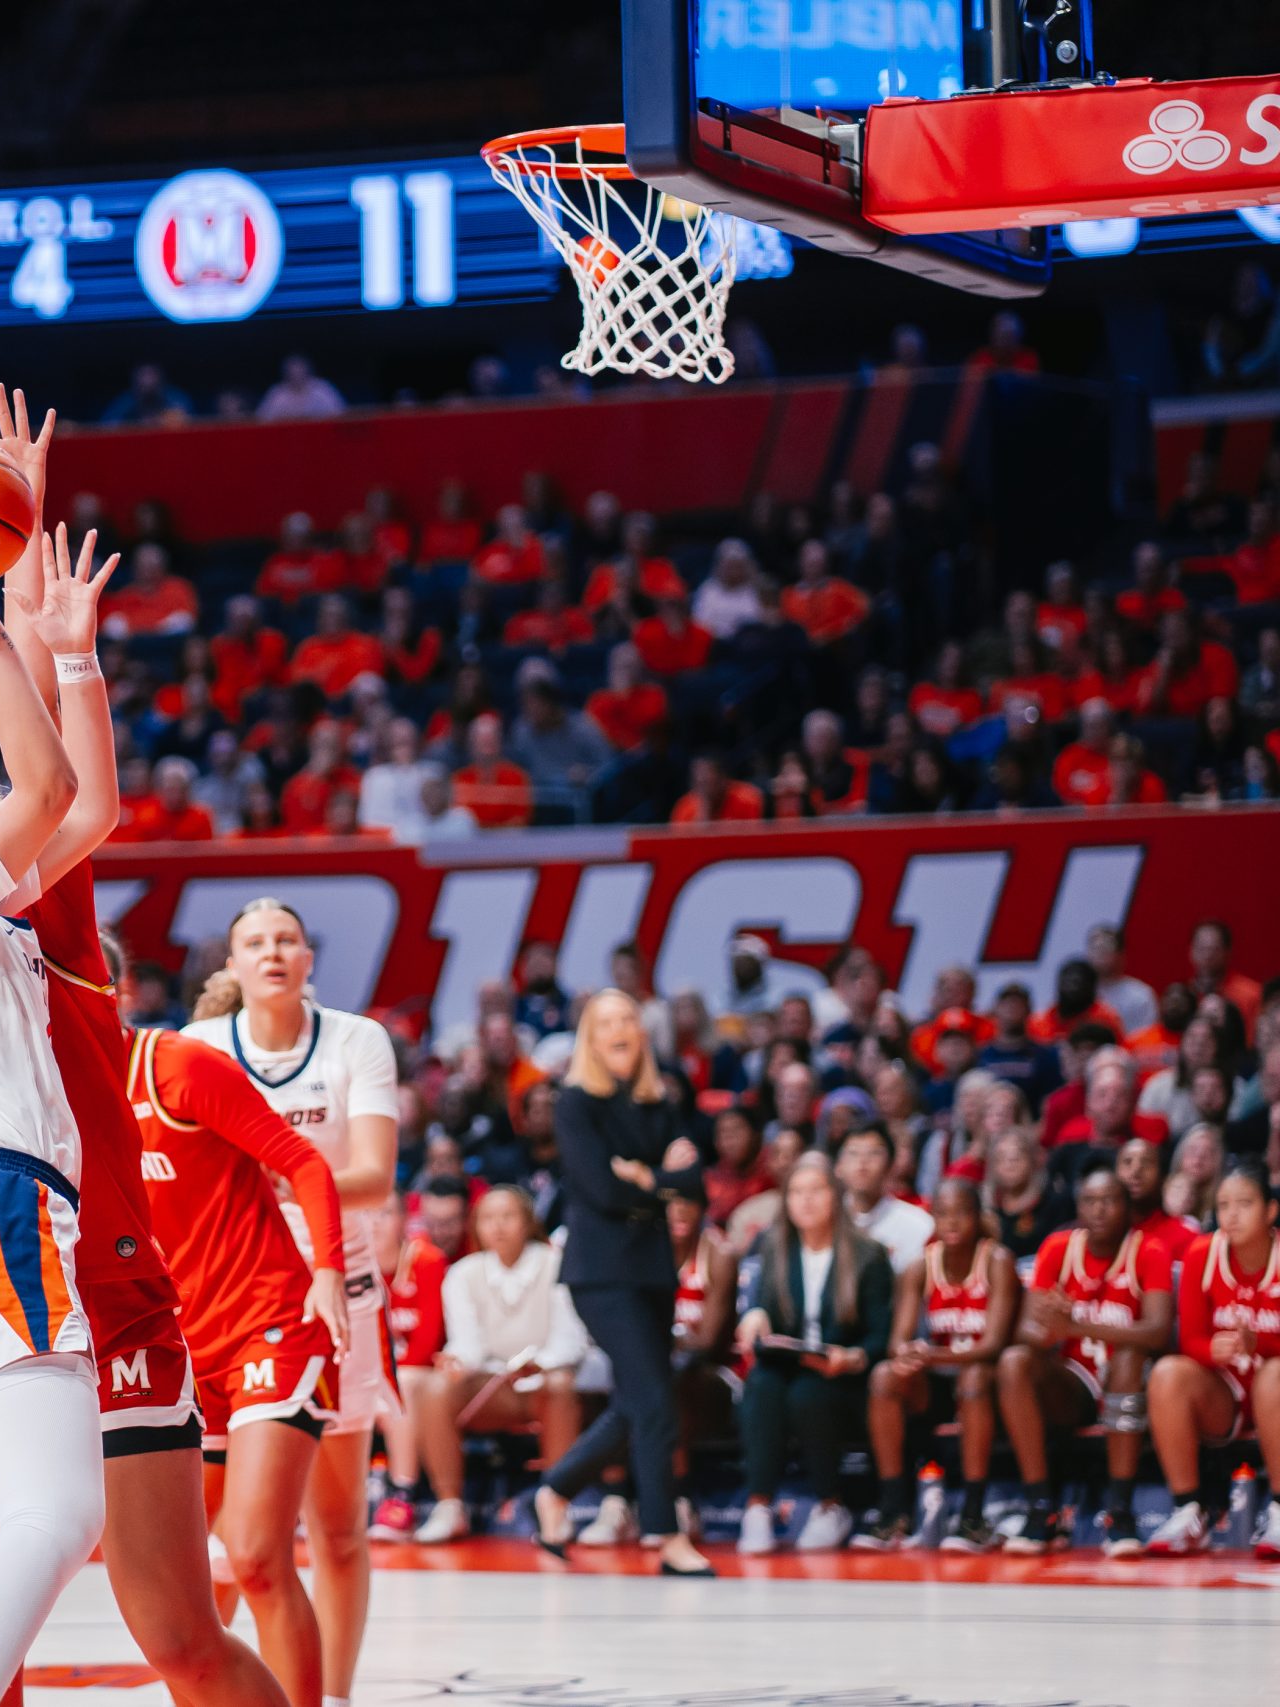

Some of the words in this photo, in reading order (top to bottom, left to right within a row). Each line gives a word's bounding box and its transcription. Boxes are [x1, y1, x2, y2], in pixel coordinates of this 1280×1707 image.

[11, 240, 73, 319] 4
[349, 170, 457, 311] 11
[94, 845, 1145, 1055] RUSH
[111, 1348, 152, 1393] M
[242, 1357, 277, 1393] M
